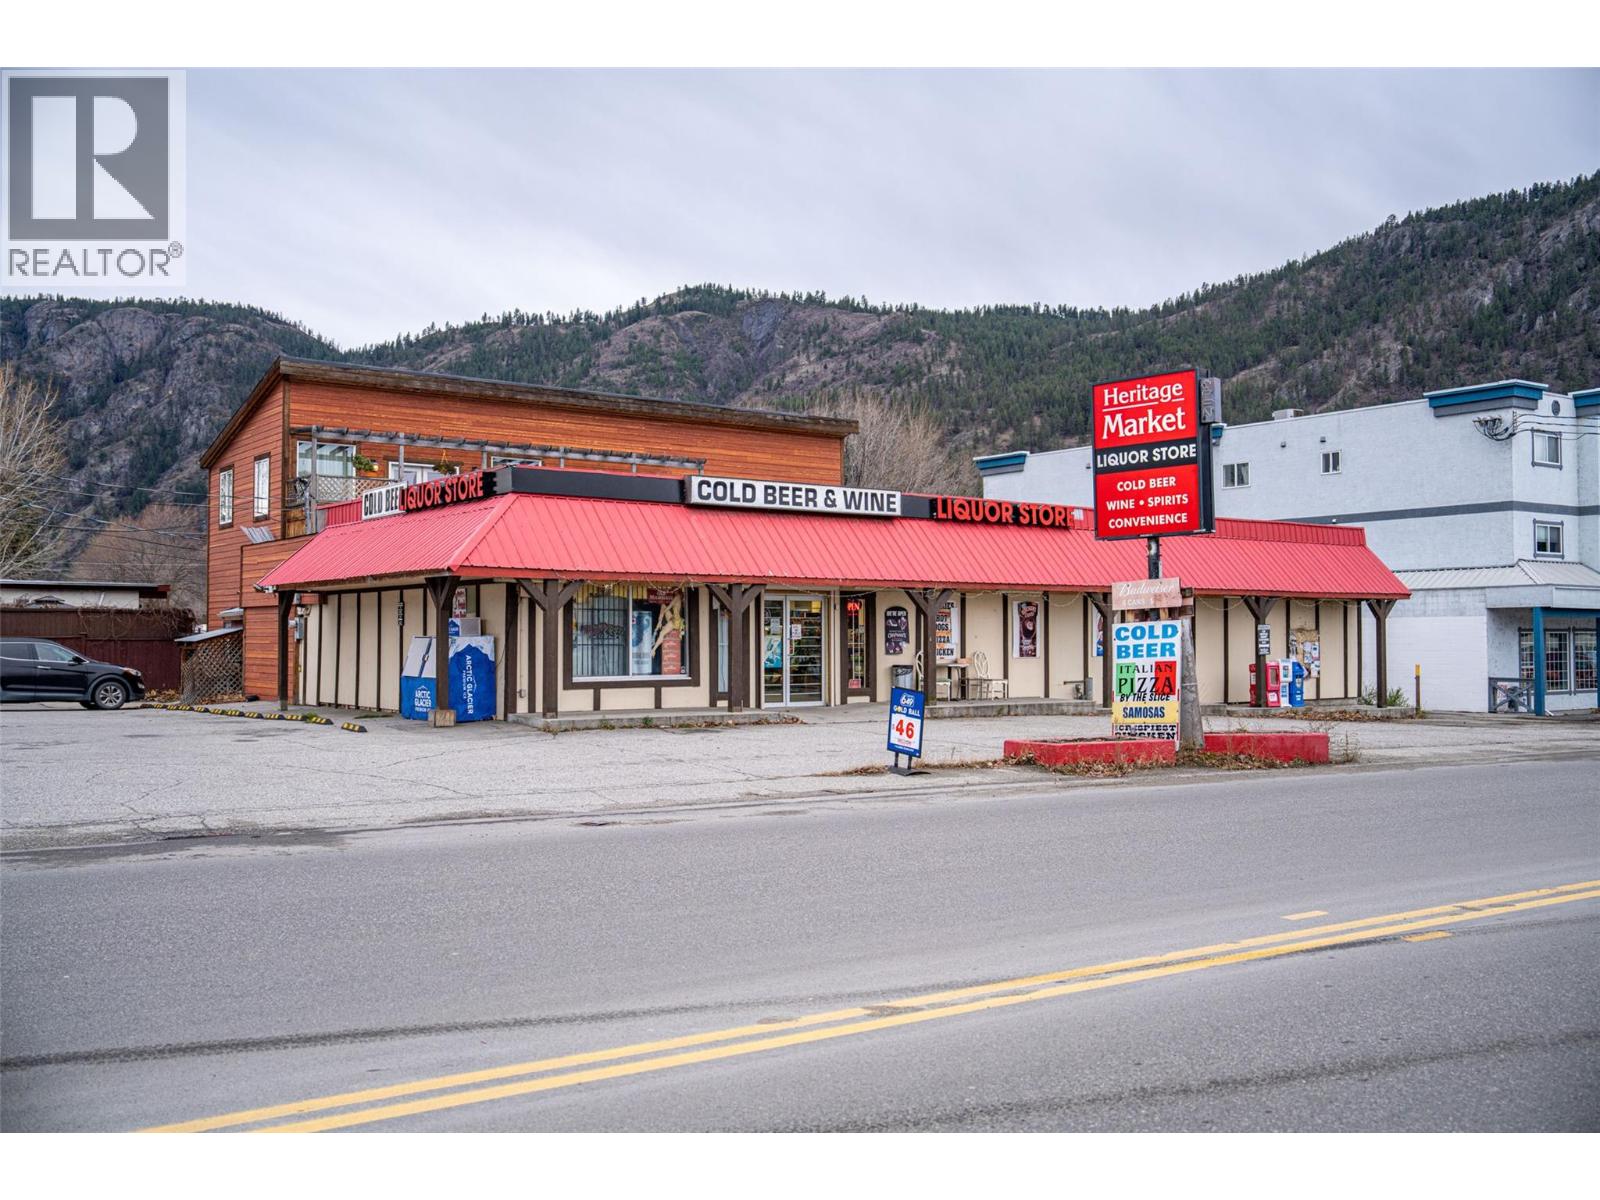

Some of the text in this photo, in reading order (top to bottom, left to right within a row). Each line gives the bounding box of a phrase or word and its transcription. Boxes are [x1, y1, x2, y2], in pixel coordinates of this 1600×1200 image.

[1103, 383, 1183, 406] Heritage
[1102, 407, 1186, 440] Market
[1097, 444, 1197, 468] LIQUOR STORE
[398, 470, 484, 511] LIQUOR STORE
[1116, 477, 1176, 492] COLD BEER
[364, 486, 399, 517] COLD BEE
[697, 480, 897, 513] COLD BEER & WINE
[1106, 494, 1189, 511] WINE SPIRITS
[936, 496, 1074, 527] LIQUOR STORE
[1108, 513, 1188, 529] CONVENIENCE
[1115, 624, 1179, 642] COLD
[1116, 642, 1176, 659] BEER
[1120, 664, 1173, 674] ITALIAN
[465, 655, 474, 714] ARCTIC GLACIER
[1119, 677, 1174, 694] PIZZA
[1120, 692, 1170, 702] BY THE SLICE
[1123, 706, 1166, 719] SAMOSAS
[895, 719, 915, 739] 46
